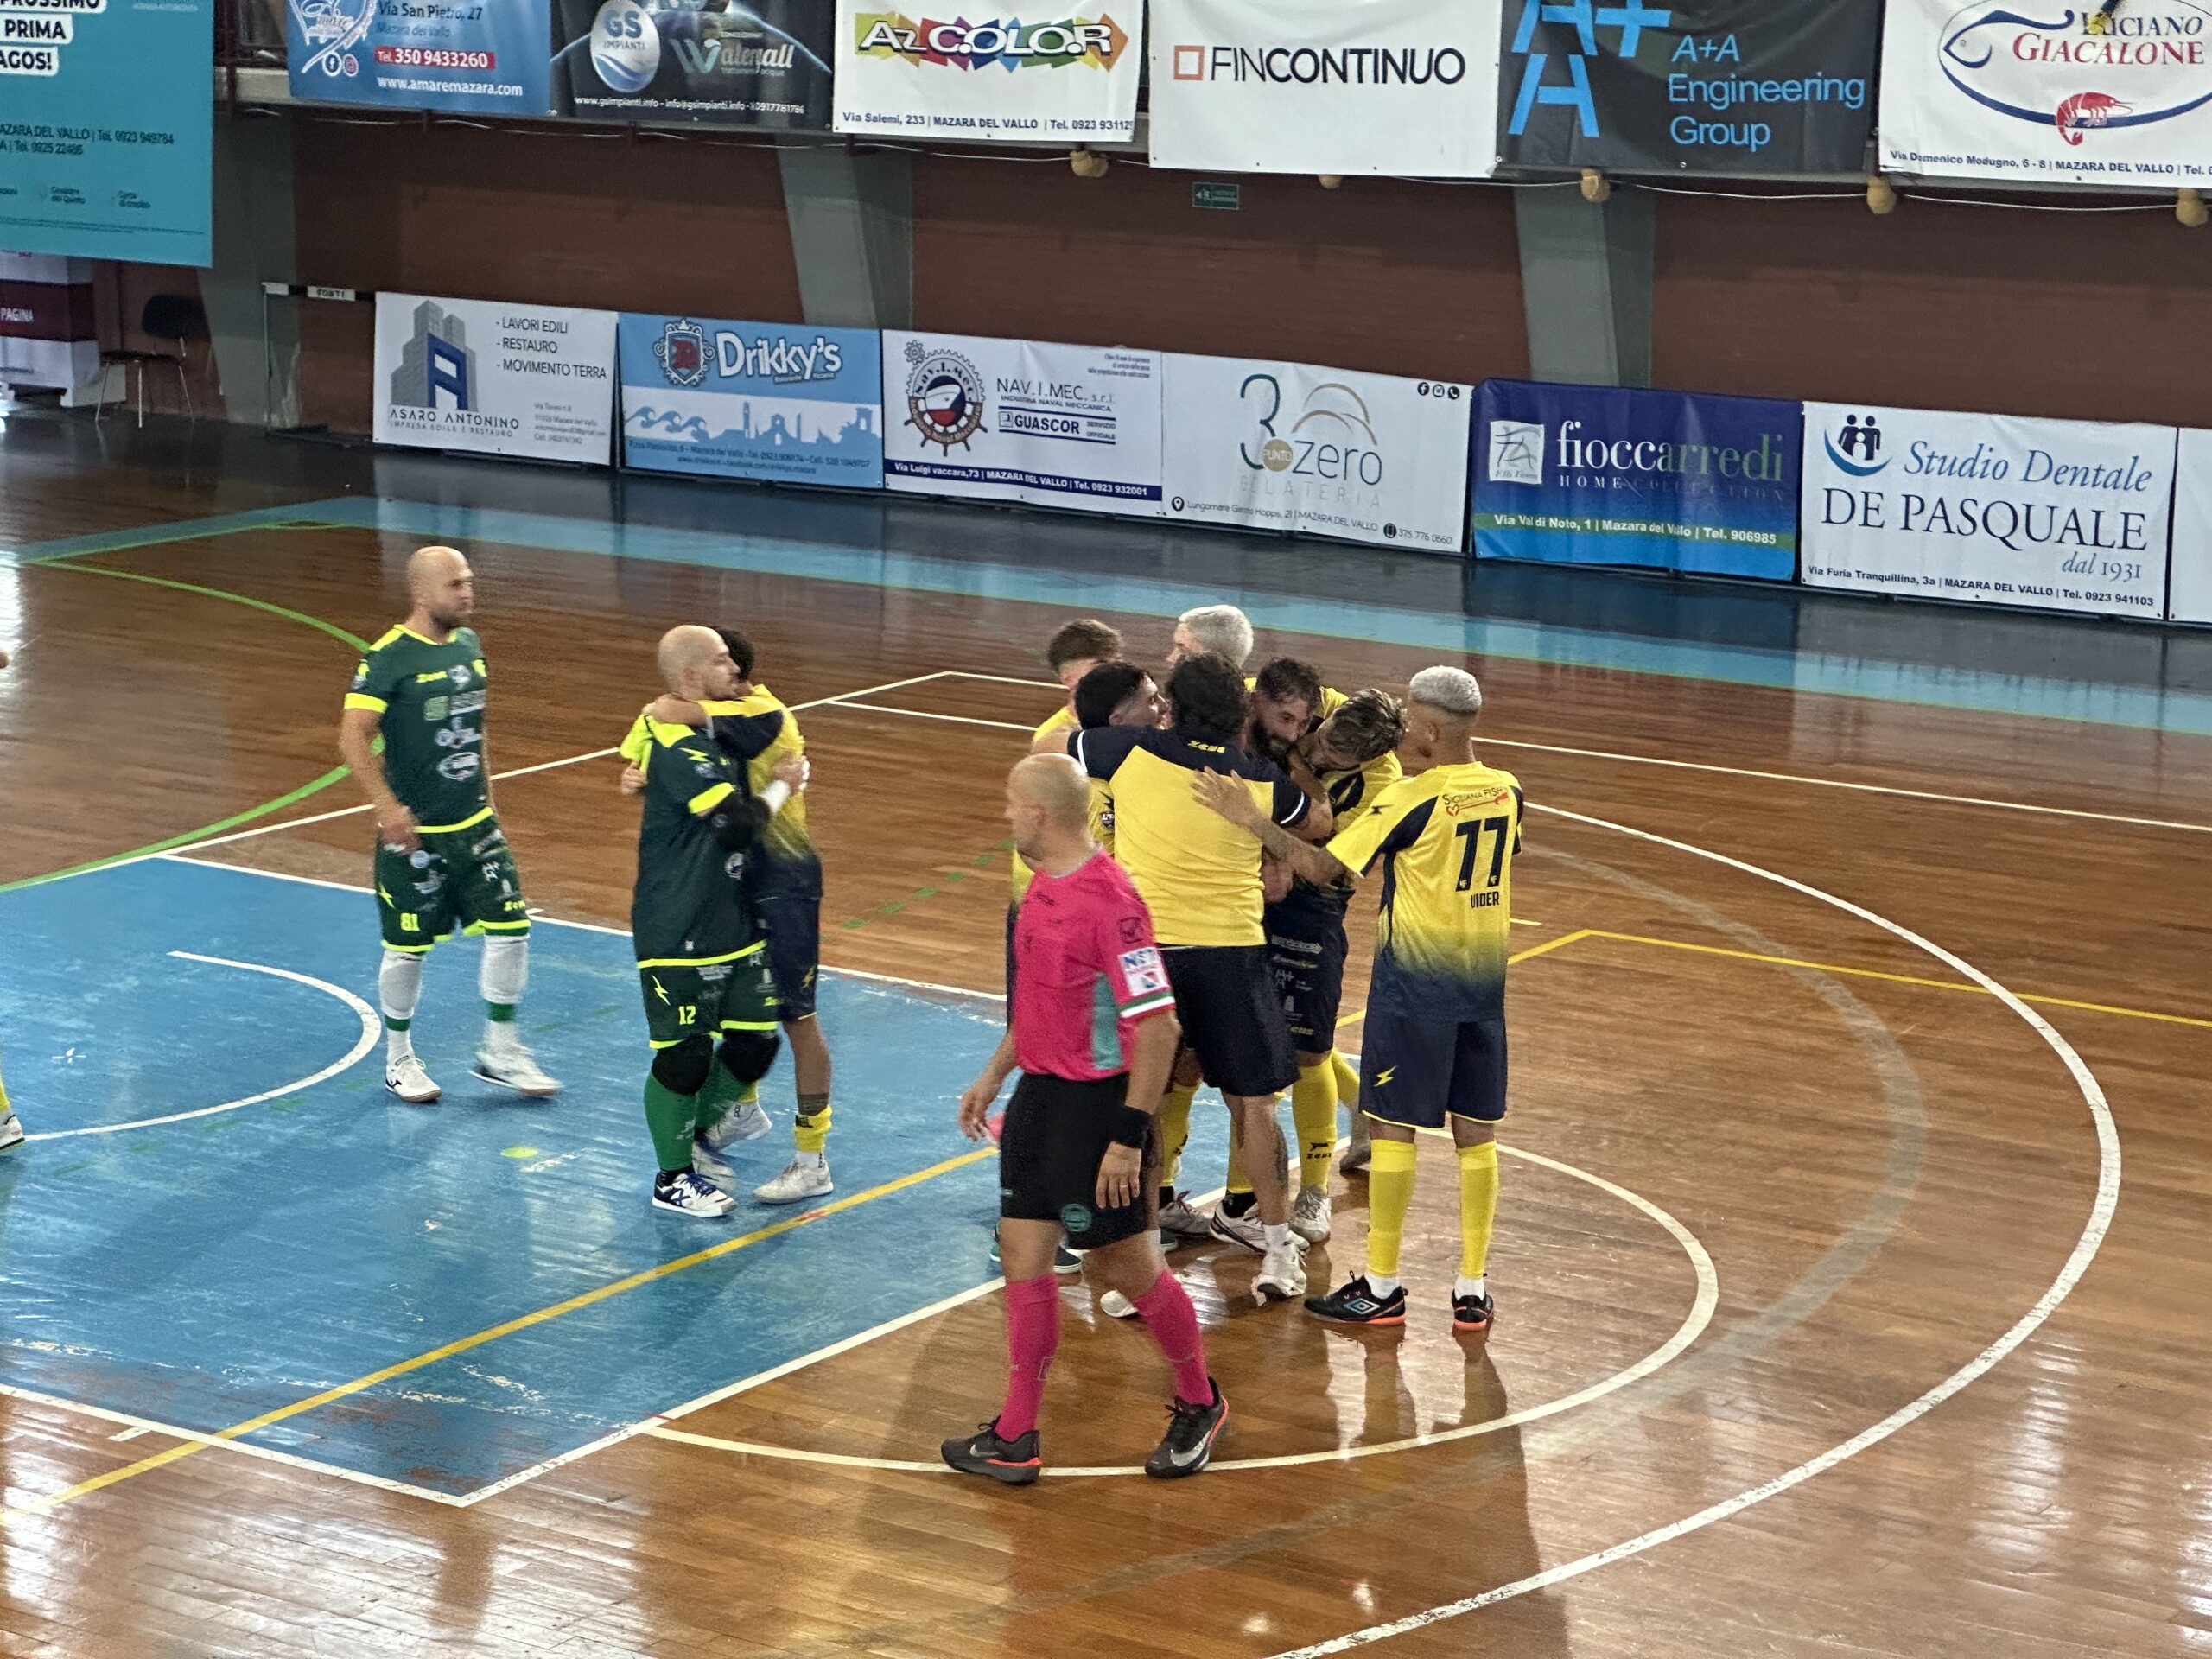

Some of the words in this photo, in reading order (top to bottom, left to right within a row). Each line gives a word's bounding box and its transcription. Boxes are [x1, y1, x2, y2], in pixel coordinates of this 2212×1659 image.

[380, 1, 397, 16] Via
[402, 3, 424, 17] San
[467, 7, 482, 20] 27
[5, 19, 66, 39] PRIMA
[603, 10, 642, 38] GS
[395, 48, 422, 64] 350
[424, 50, 488, 67] 9433260
[604, 40, 645, 50] IMPIANTI
[1671, 35, 1740, 62] A+A
[2012, 32, 2205, 65] GIACALONE
[1211, 47, 1466, 85] FINCONTINUO
[377, 76, 523, 97] www.amaremazara.com
[1668, 72, 1865, 110] Engineering
[35, 126, 54, 138] DEL
[57, 127, 89, 139] VALLO
[842, 112, 861, 122] Via
[865, 112, 902, 125] Salemi,
[906, 115, 925, 124] 233
[934, 117, 976, 127] MAZARA
[979, 118, 999, 128] DEL
[1003, 119, 1038, 129] VALLO
[1051, 119, 1069, 129] Tel.
[1072, 120, 1096, 130] 0923
[1669, 115, 1771, 152] Group
[1890, 151, 1907, 161] Via
[1910, 152, 1963, 164] Domenico
[1967, 156, 2019, 168] Modugno,
[2056, 160, 2105, 172] MAZARA
[2109, 162, 2131, 172] DEL
[2135, 163, 2174, 173] VALLO
[2184, 165, 2205, 175] Tel.
[1, 308, 34, 322] PAGINA
[502, 317, 539, 331] LAVORI
[543, 320, 568, 334] EDILI
[503, 337, 558, 353] RESTAURO
[716, 332, 842, 379] Drikky's
[504, 359, 570, 376] MOVIMENTO
[573, 365, 607, 379] TERRA
[391, 409, 436, 422] ASARO
[445, 413, 519, 429] ANTONINO
[1065, 403, 1112, 412] MECCANICA
[1014, 415, 1080, 434] GUASCOR
[1293, 440, 1382, 486] zero
[1556, 420, 1784, 481] fioccarredi
[1904, 440, 2009, 480] Studio
[2020, 448, 2153, 492] Dentale
[895, 463, 909, 472] Via
[910, 464, 931, 475] Luigi
[987, 471, 1023, 481] MAZARA
[1025, 474, 1039, 484] DEL
[1040, 477, 1068, 487] VALLO
[1074, 480, 1090, 490] Tel.
[1092, 482, 1113, 492] 0923
[1115, 485, 1147, 496] 932001
[1560, 475, 1623, 489] HOME
[1187, 500, 1230, 512] Lungomare
[1298, 511, 1332, 524] MAZARA
[1334, 516, 1349, 525] DEL
[1351, 519, 1378, 531] VALLO
[1821, 487, 1885, 529] DE
[1899, 493, 2148, 551] PASQUALE
[1494, 514, 1516, 525] Via
[1549, 518, 1580, 531] Noto,
[1584, 519, 1592, 530] 1
[1602, 520, 1647, 532] Mazara
[1649, 523, 1664, 533] del
[1703, 527, 1729, 540] Tel.
[1731, 530, 1777, 544] 906985
[2062, 550, 2097, 575] dal
[2101, 563, 2142, 582] 1931
[1808, 566, 1824, 575] Via
[1827, 568, 1852, 579] Furia
[1855, 570, 1919, 585] Tranquillina,
[1923, 576, 1936, 586] 3a
[1945, 578, 1991, 590] MAZARA
[1994, 582, 2014, 593] DEL
[2018, 585, 2053, 596] VALLO
[2063, 589, 2082, 600] Tel.
[2085, 592, 2112, 602] 0923
[2115, 594, 2153, 606] 941103
[1455, 815, 1509, 892] 77
[678, 1005, 696, 1026] 12
